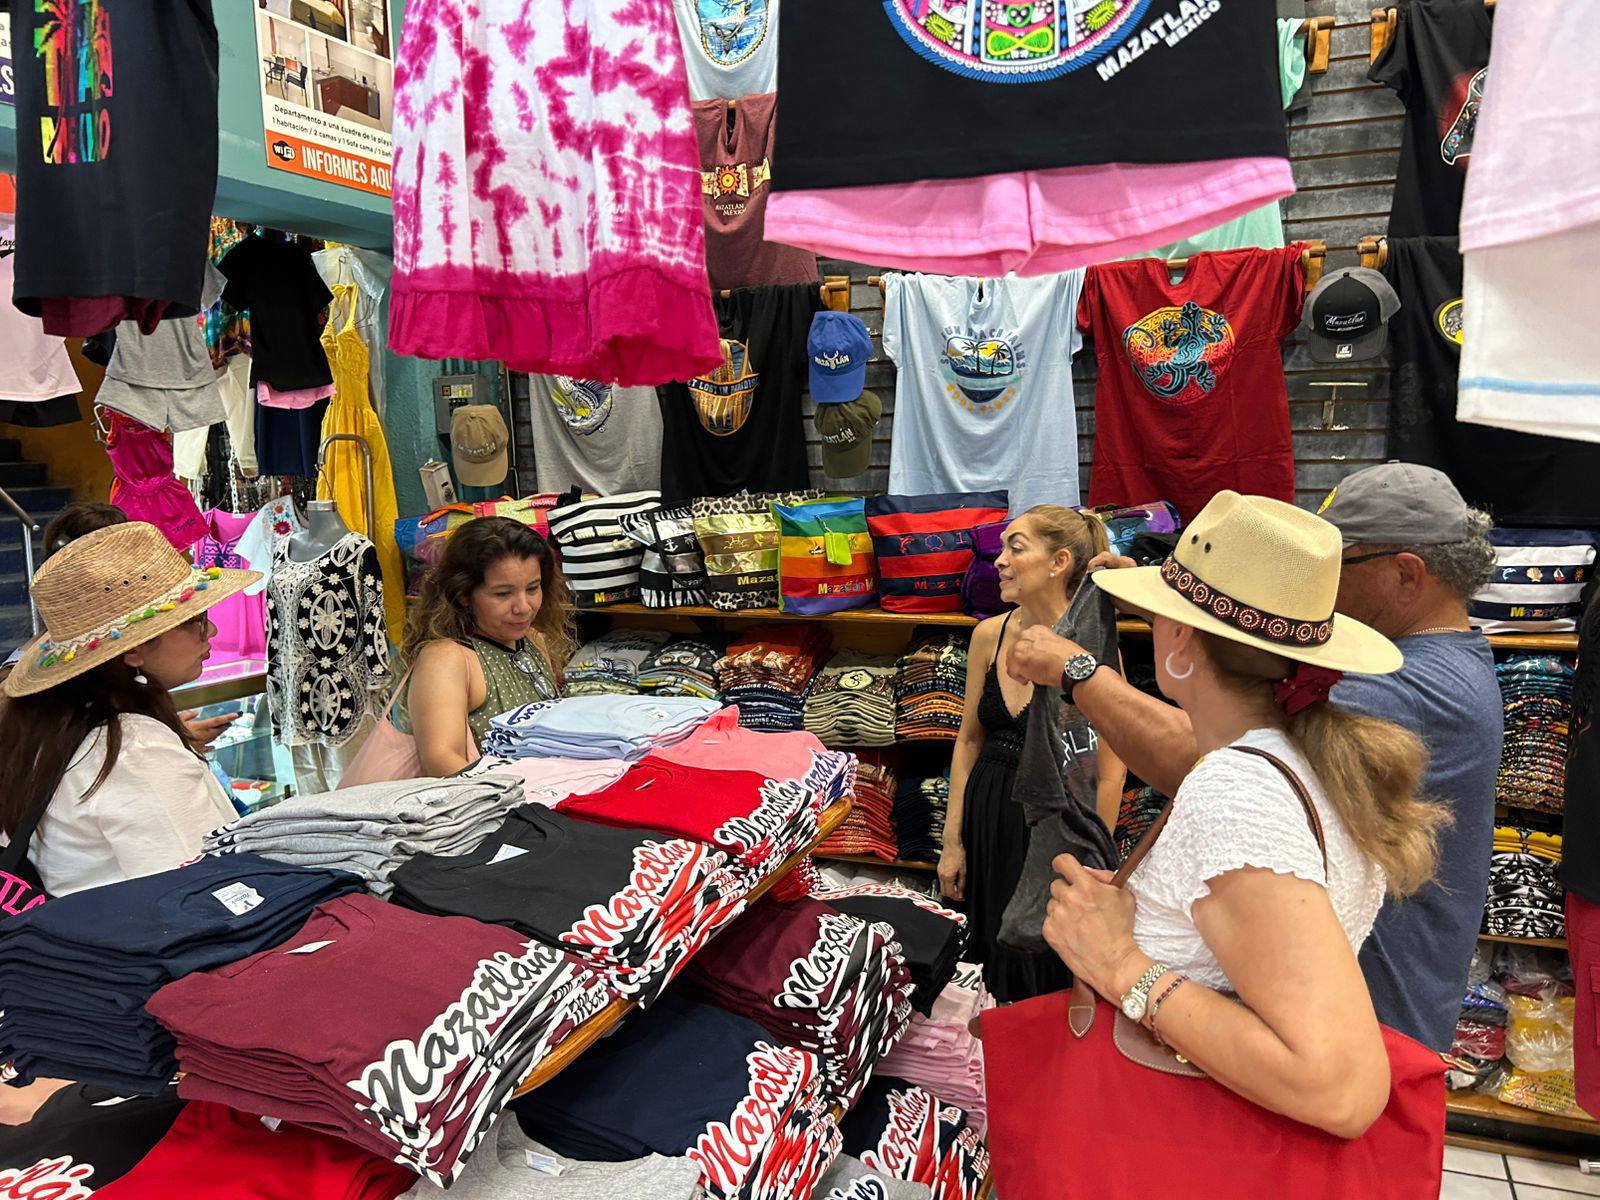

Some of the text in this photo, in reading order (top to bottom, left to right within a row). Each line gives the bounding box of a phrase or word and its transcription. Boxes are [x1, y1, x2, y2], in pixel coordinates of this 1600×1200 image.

[1165, 0, 1222, 47] MEXICO
[274, 104, 321, 125] Departamento
[328, 122, 340, 131] una
[341, 125, 361, 137] cuadra
[362, 132, 370, 140] de
[276, 119, 309, 134] habitación
[319, 132, 337, 142] camas
[359, 144, 374, 153] cama
[301, 145, 368, 184] INFORMES
[367, 941, 558, 1117] Mazatlán
